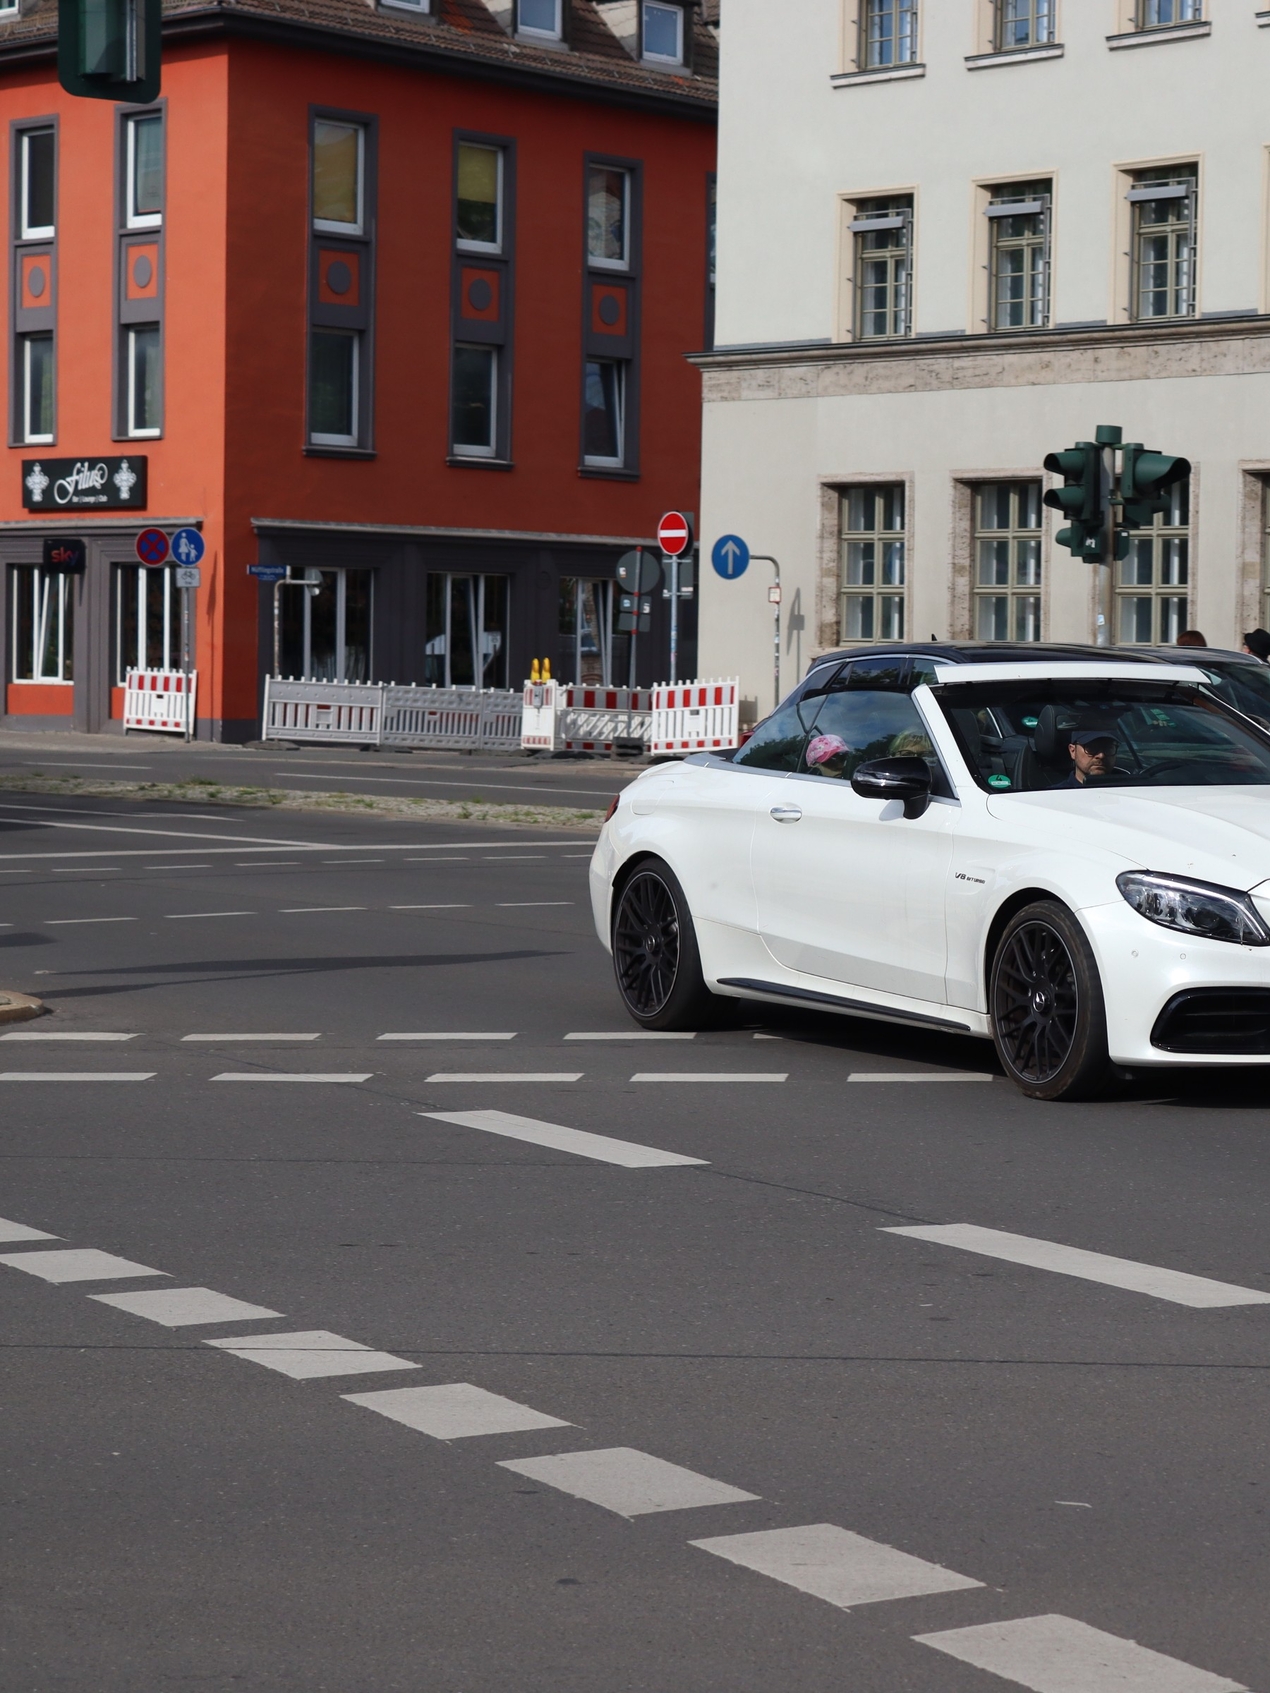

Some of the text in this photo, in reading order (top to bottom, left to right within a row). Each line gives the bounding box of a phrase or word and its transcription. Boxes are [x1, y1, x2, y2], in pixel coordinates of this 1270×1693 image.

[51, 546, 79, 566] sky
[995, 774, 1003, 782] 4
[954, 872, 967, 880] V8
